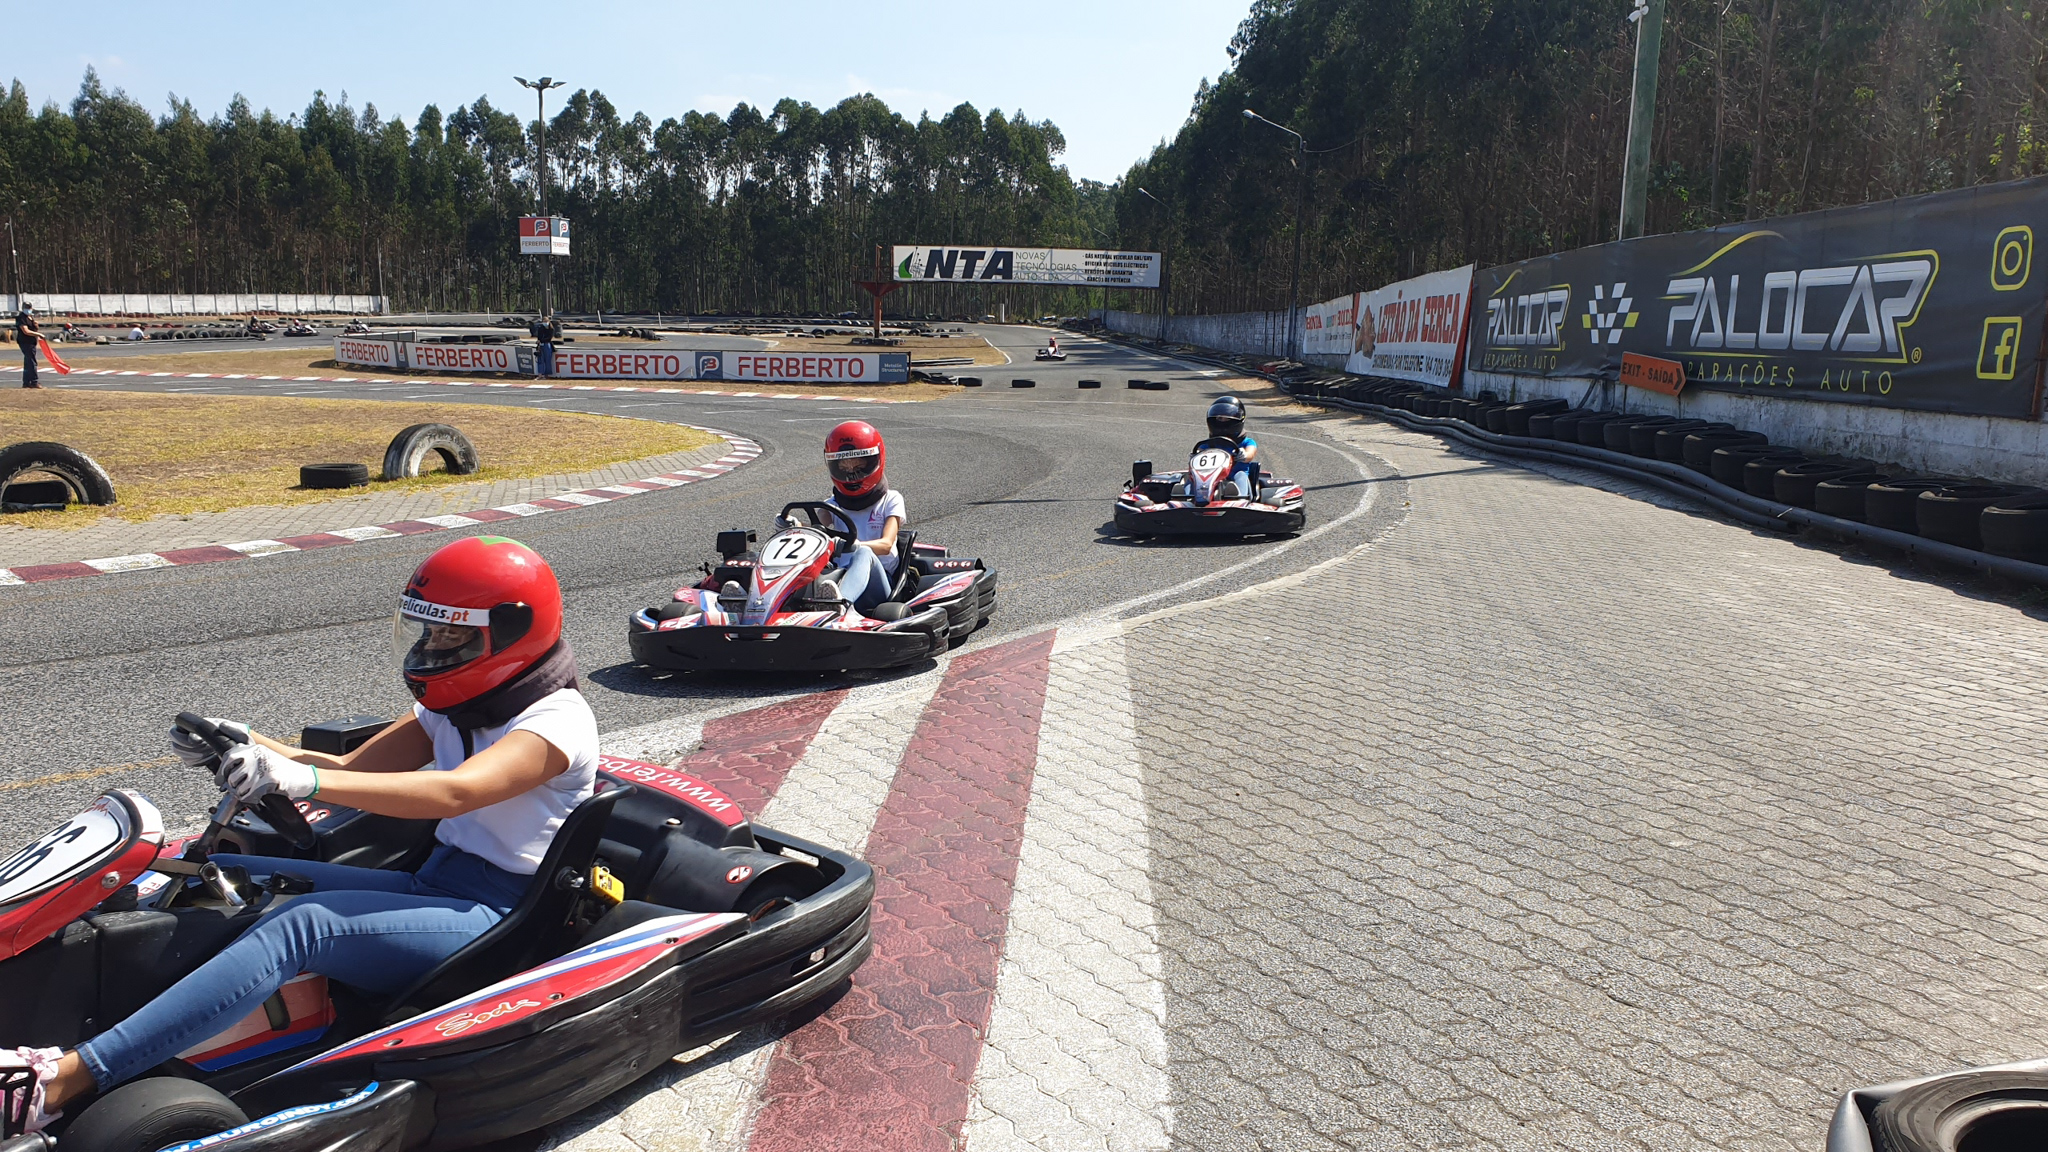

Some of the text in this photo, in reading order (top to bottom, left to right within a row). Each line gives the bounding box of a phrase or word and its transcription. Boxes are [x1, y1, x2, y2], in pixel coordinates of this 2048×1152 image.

[924, 250, 1013, 280] NTA
[1016, 252, 1045, 260] NOVAS
[1016, 262, 1077, 271] TECNOLOGIAS
[1486, 289, 1569, 345] PALOCAR
[1666, 259, 1930, 353] PALOCAR
[1404, 298, 1421, 343] DA
[1420, 293, 1461, 344] CERCA
[340, 341, 389, 363] FERBERTO
[415, 347, 508, 368] FERBERTO
[1532, 354, 1556, 370] AUTO
[555, 354, 680, 375] FERBERTO
[738, 356, 865, 378] FERBERTO
[1621, 362, 1674, 385] EXIT SAÍDA
[1687, 361, 1893, 394] PARAÇÕES AUTO
[1199, 455, 1217, 467] 61
[772, 538, 806, 560] 72
[400, 599, 469, 623] eliculas.pt
